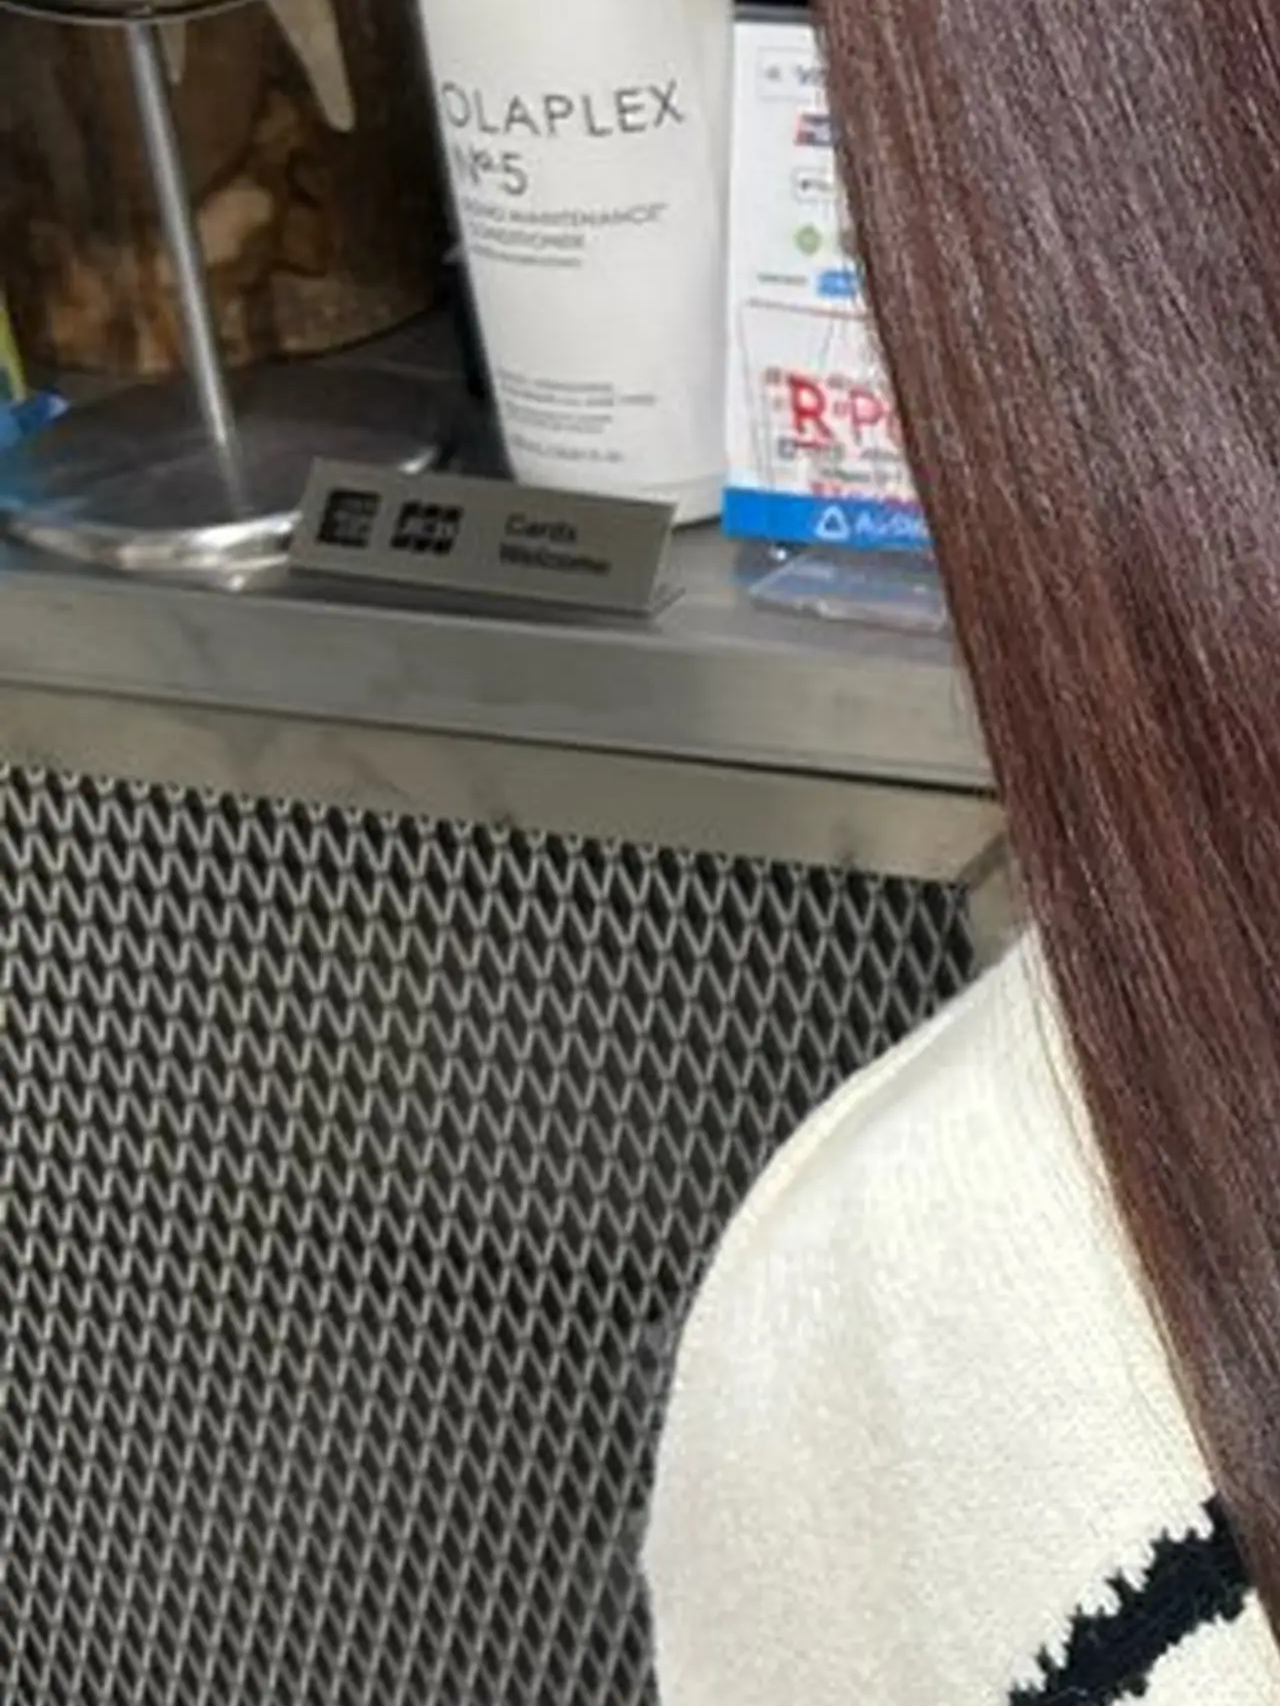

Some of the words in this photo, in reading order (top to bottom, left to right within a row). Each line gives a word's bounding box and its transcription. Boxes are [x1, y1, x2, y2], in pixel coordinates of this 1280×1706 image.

[441, 78, 686, 139] OLAPLEX
[503, 511, 579, 547] Cards
[500, 542, 613, 579] Welcome
